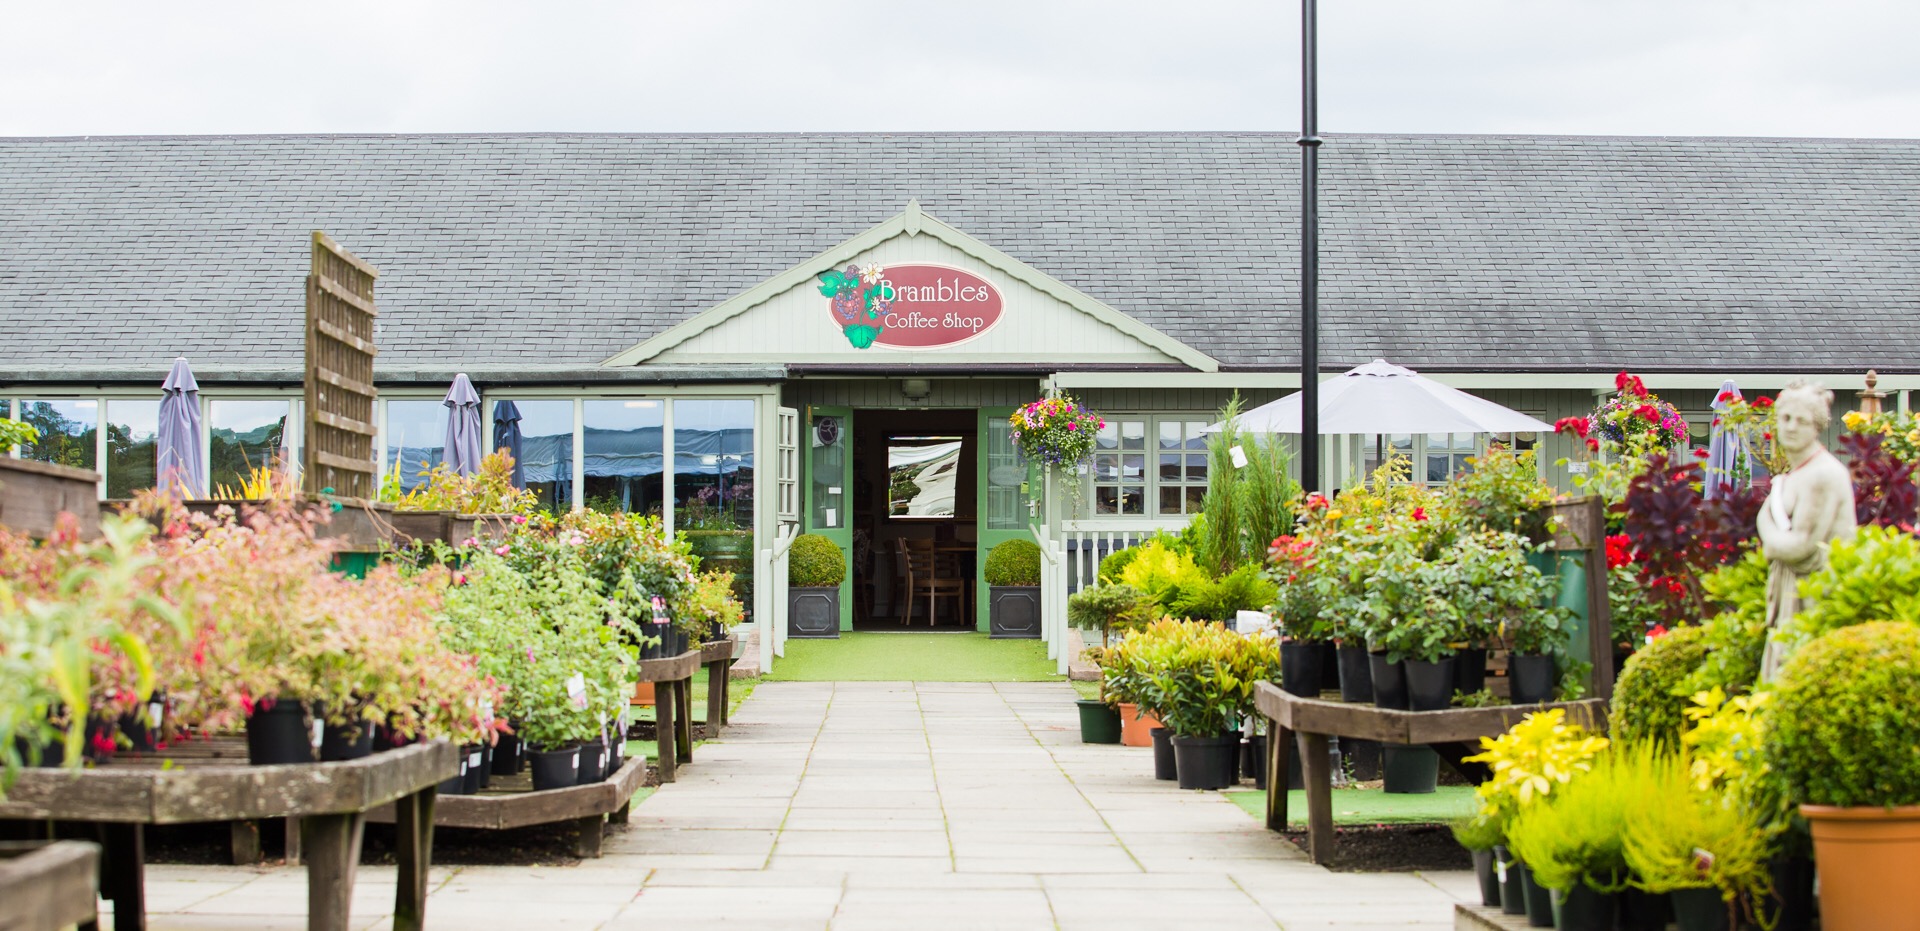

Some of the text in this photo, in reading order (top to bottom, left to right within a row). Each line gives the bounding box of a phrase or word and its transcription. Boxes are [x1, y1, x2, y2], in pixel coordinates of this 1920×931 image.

[880, 277, 989, 302] Brambles
[884, 311, 984, 333] Coffee Shop
